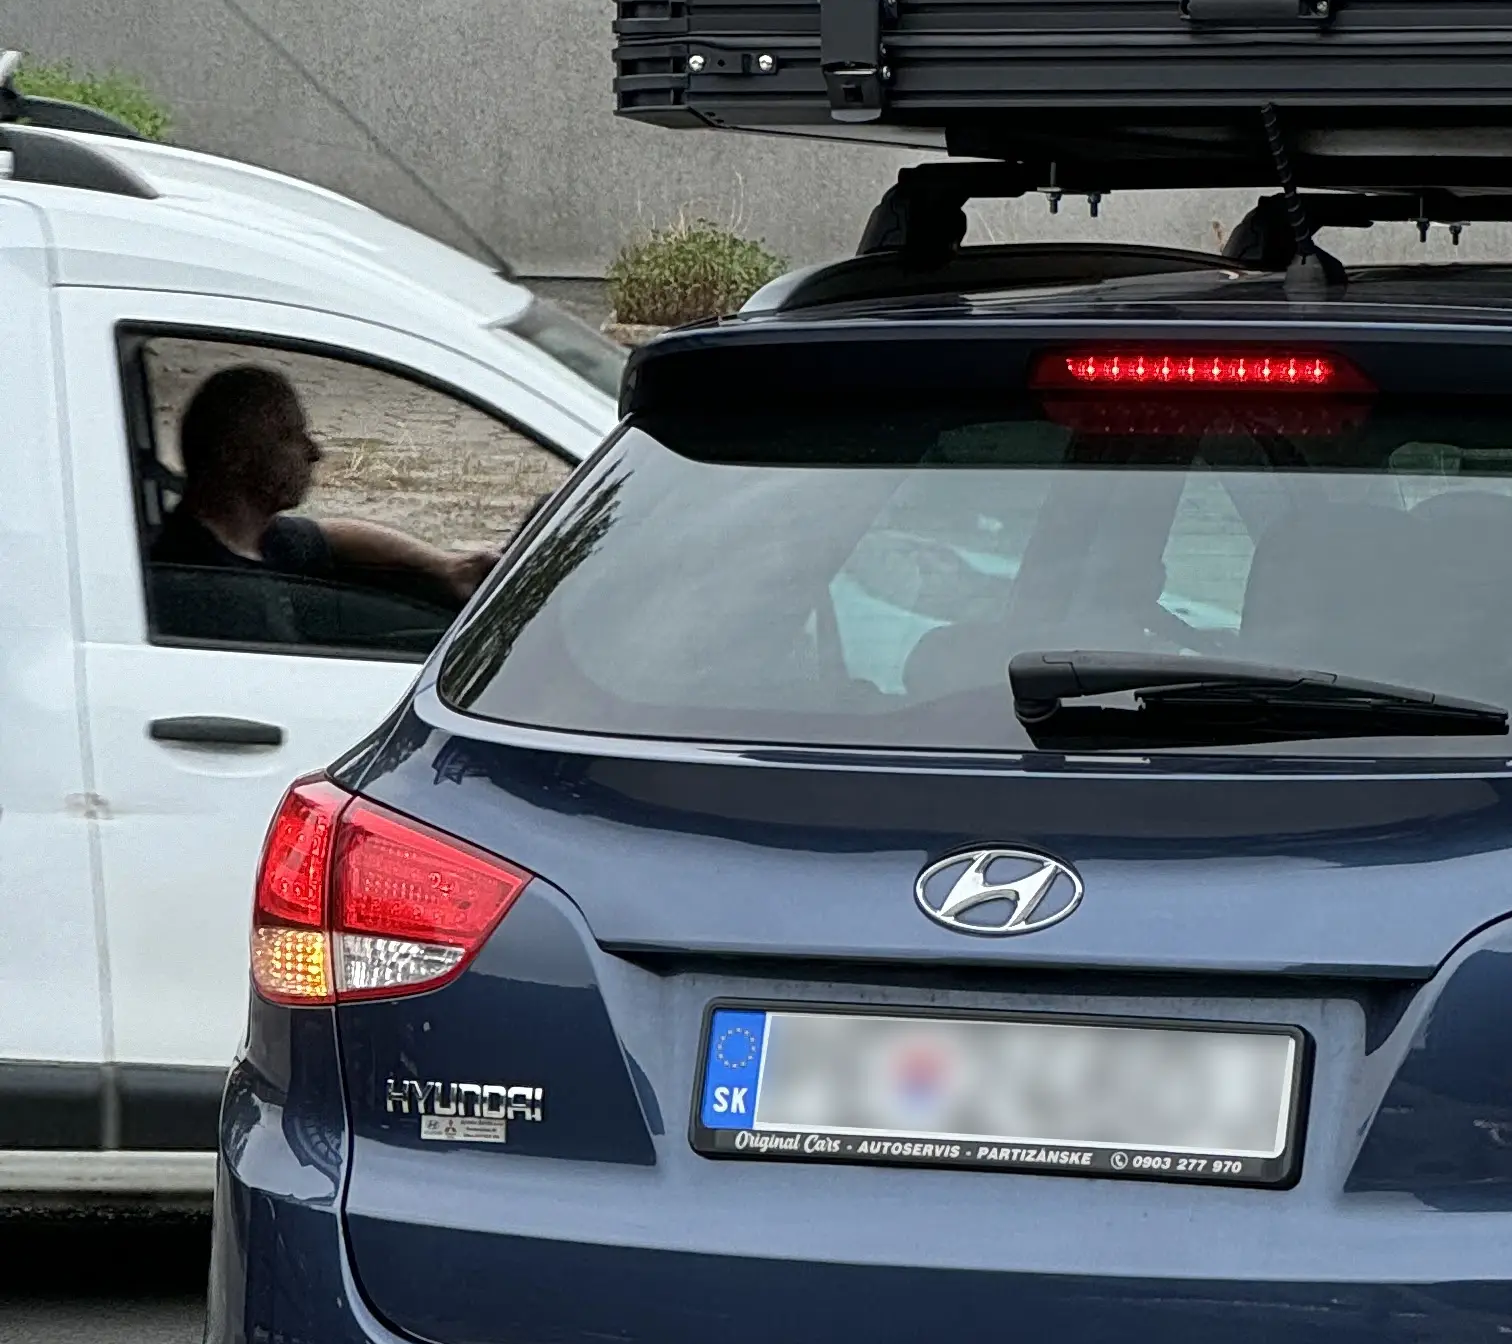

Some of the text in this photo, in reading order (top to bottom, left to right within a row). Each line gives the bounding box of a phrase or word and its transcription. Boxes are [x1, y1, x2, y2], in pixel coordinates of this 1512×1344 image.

[386, 1078, 543, 1122] HYUNDAI
[712, 1086, 748, 1114] SK
[734, 1130, 1243, 1174] Original Cars AUTOSERVIS PARTIZÁNSKE 0903 277 970
